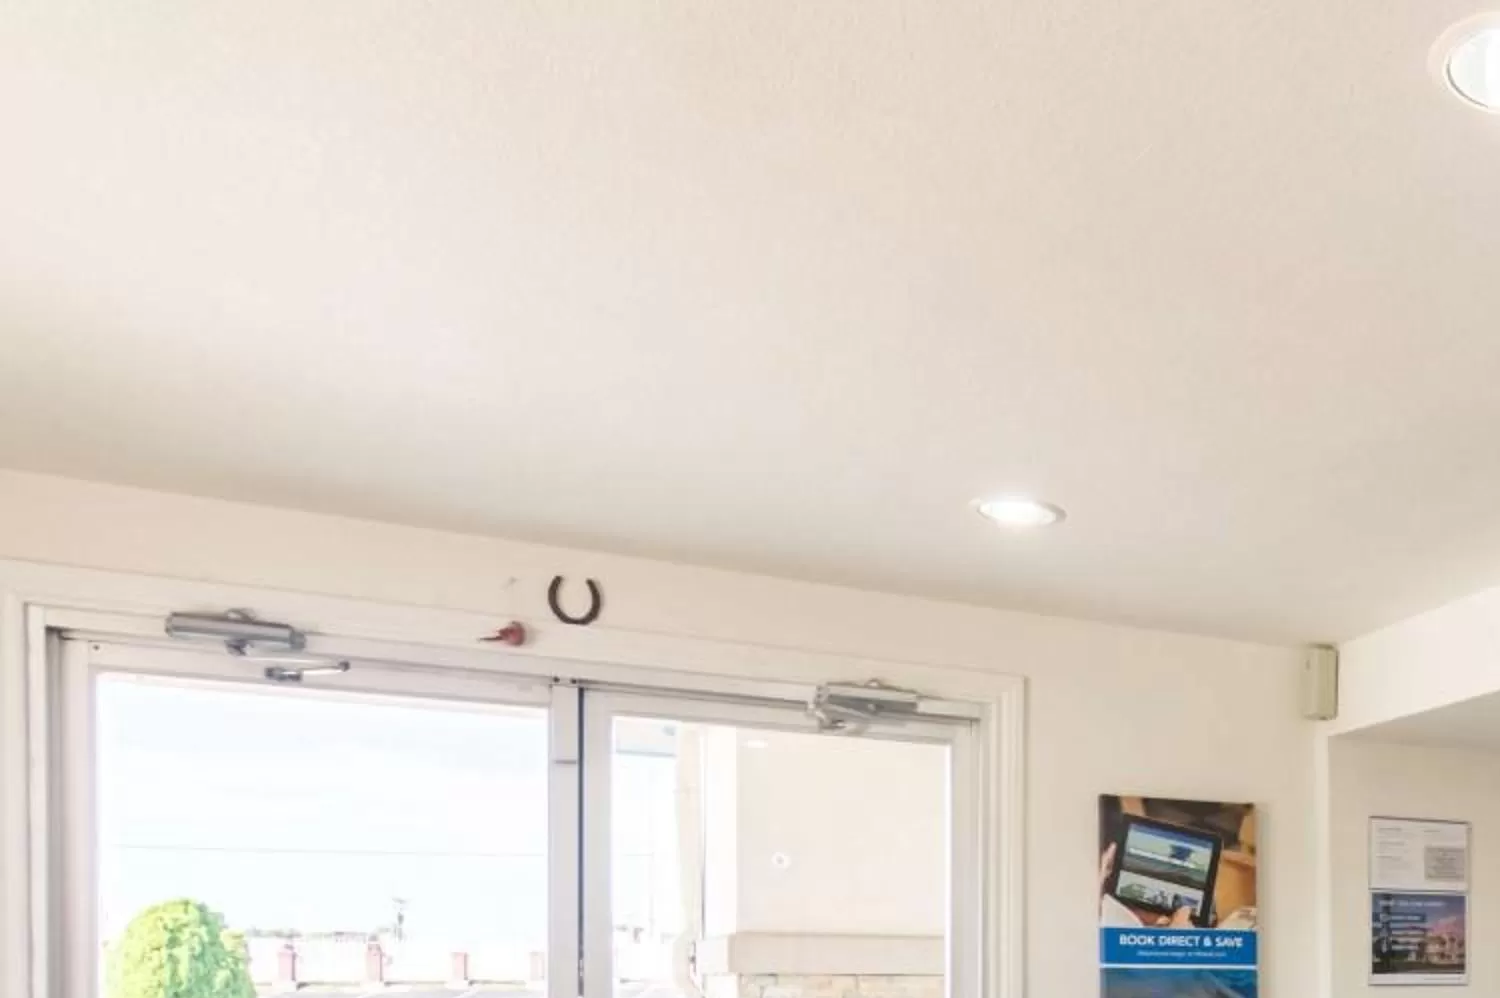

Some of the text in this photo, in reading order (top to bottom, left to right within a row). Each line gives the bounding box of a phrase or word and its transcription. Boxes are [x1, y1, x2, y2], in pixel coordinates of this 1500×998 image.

[1119, 934, 1243, 948] BOOK DIRECT & SAVE
